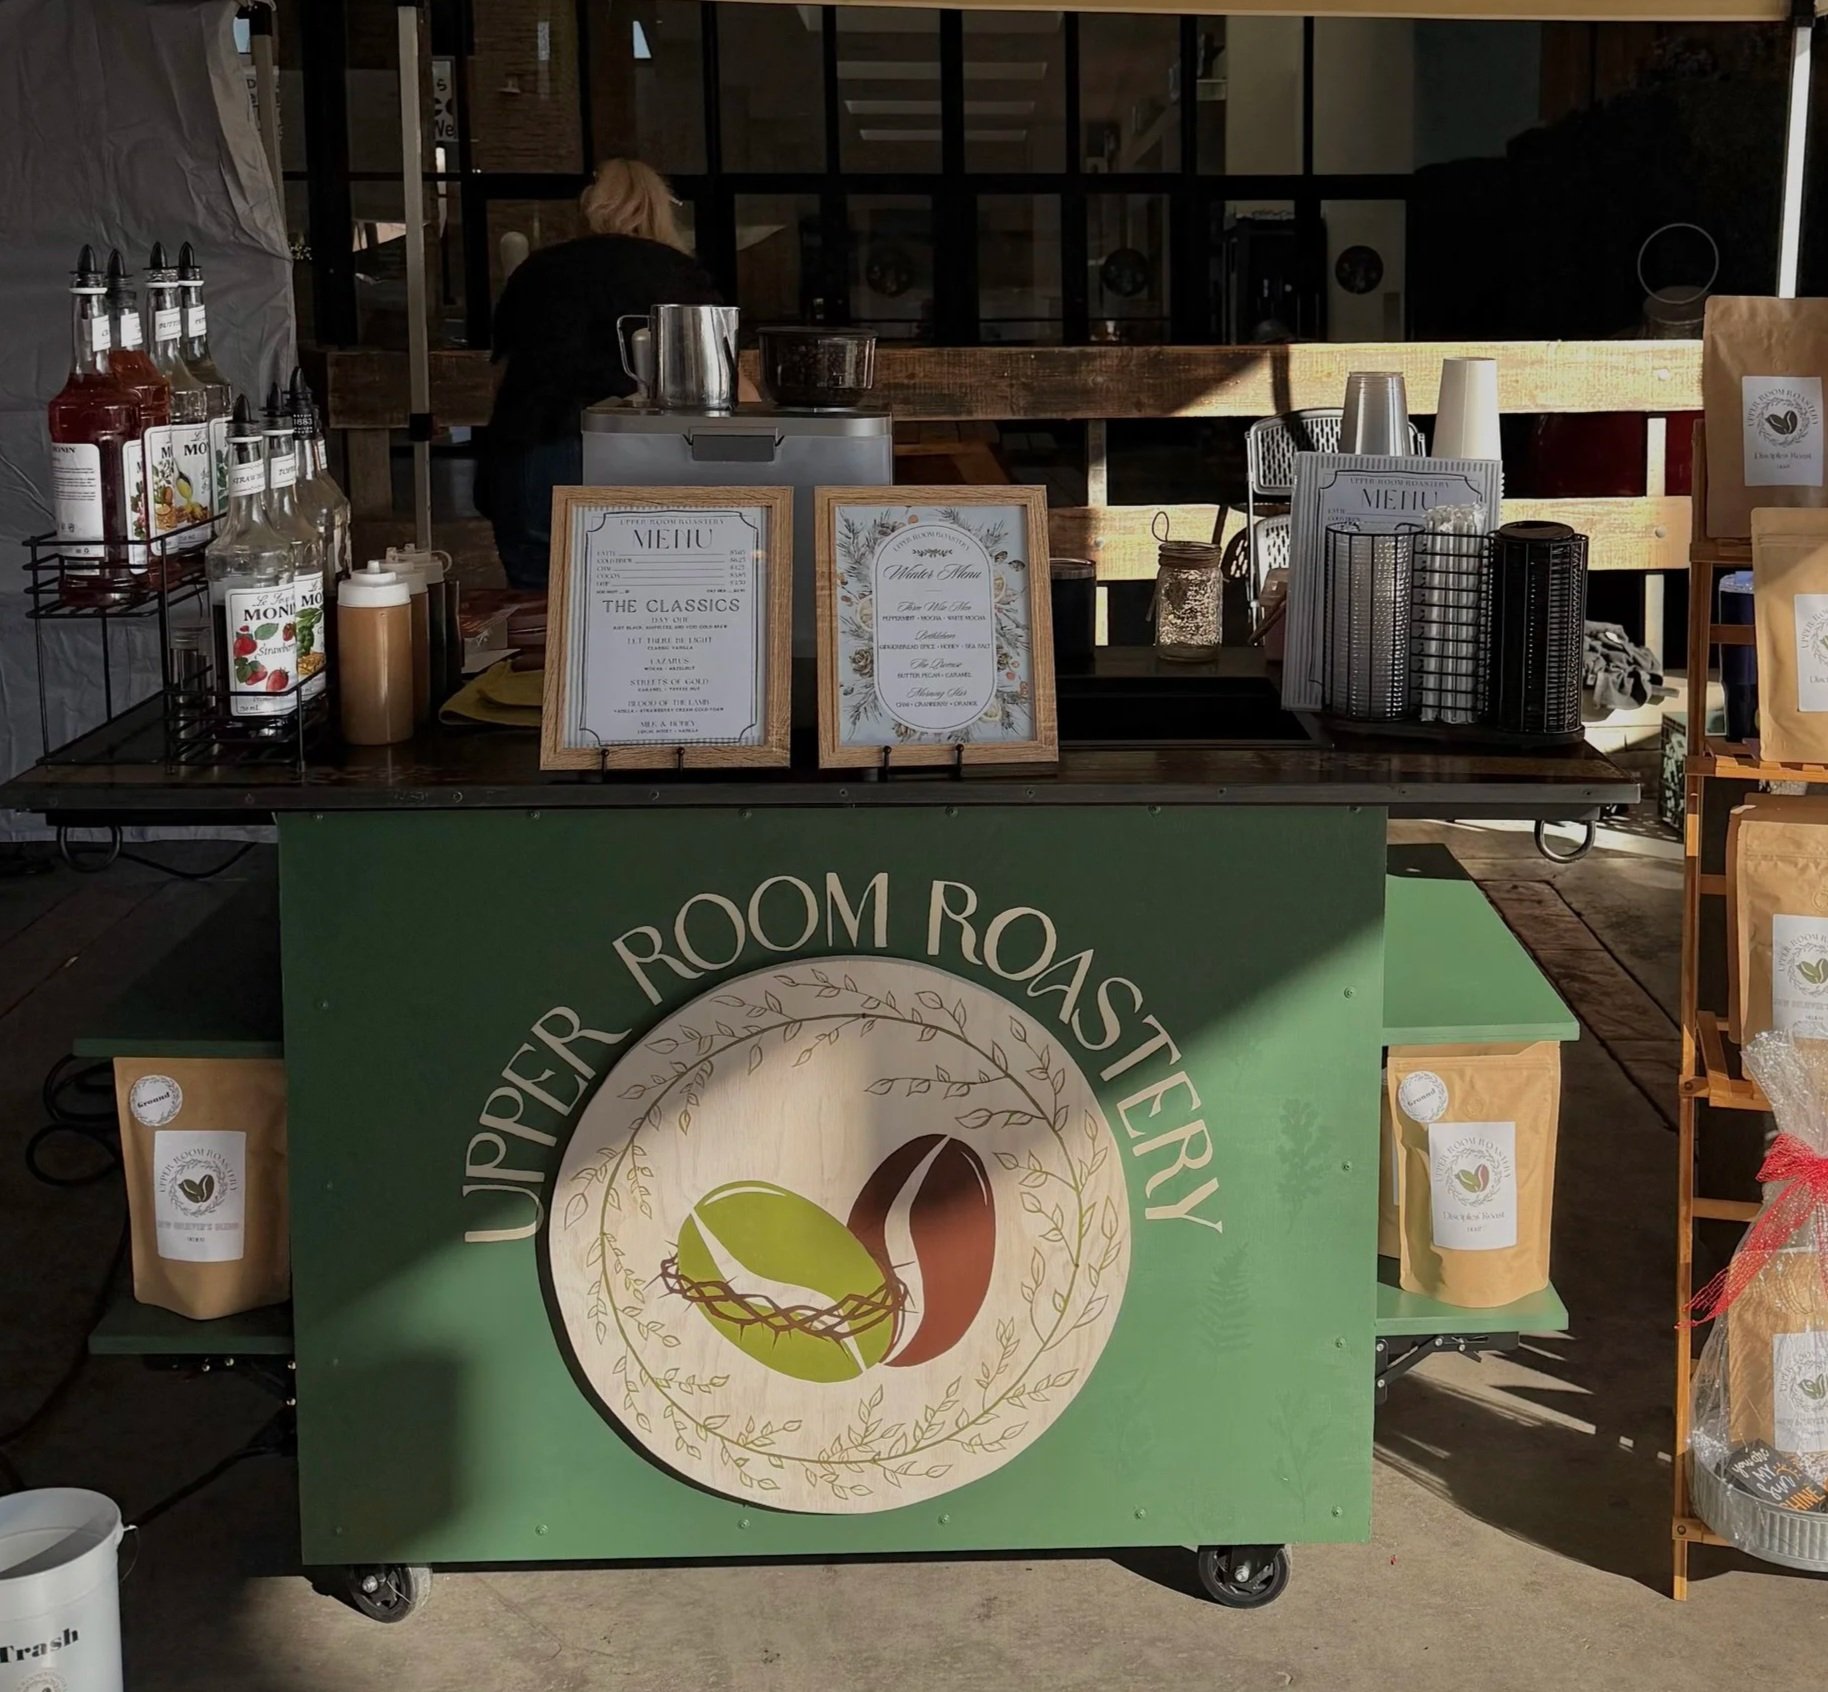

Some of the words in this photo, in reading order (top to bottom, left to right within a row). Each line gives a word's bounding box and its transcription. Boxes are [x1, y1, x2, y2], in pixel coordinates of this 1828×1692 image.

[293, 418, 313, 426] 1883
[1362, 488, 1438, 511] MENU
[633, 528, 713, 549] MENU
[883, 563, 934, 580] Winter
[937, 563, 982, 580] Menu
[602, 599, 637, 613] THE
[646, 598, 740, 613] CLASSICS
[460, 1005, 632, 1243] UPPER
[612, 872, 889, 1006] ROOM
[927, 879, 1223, 1235] ROASTERY
[1752, 1463, 1776, 1483] MY
[0, 1628, 79, 1664] Trash
